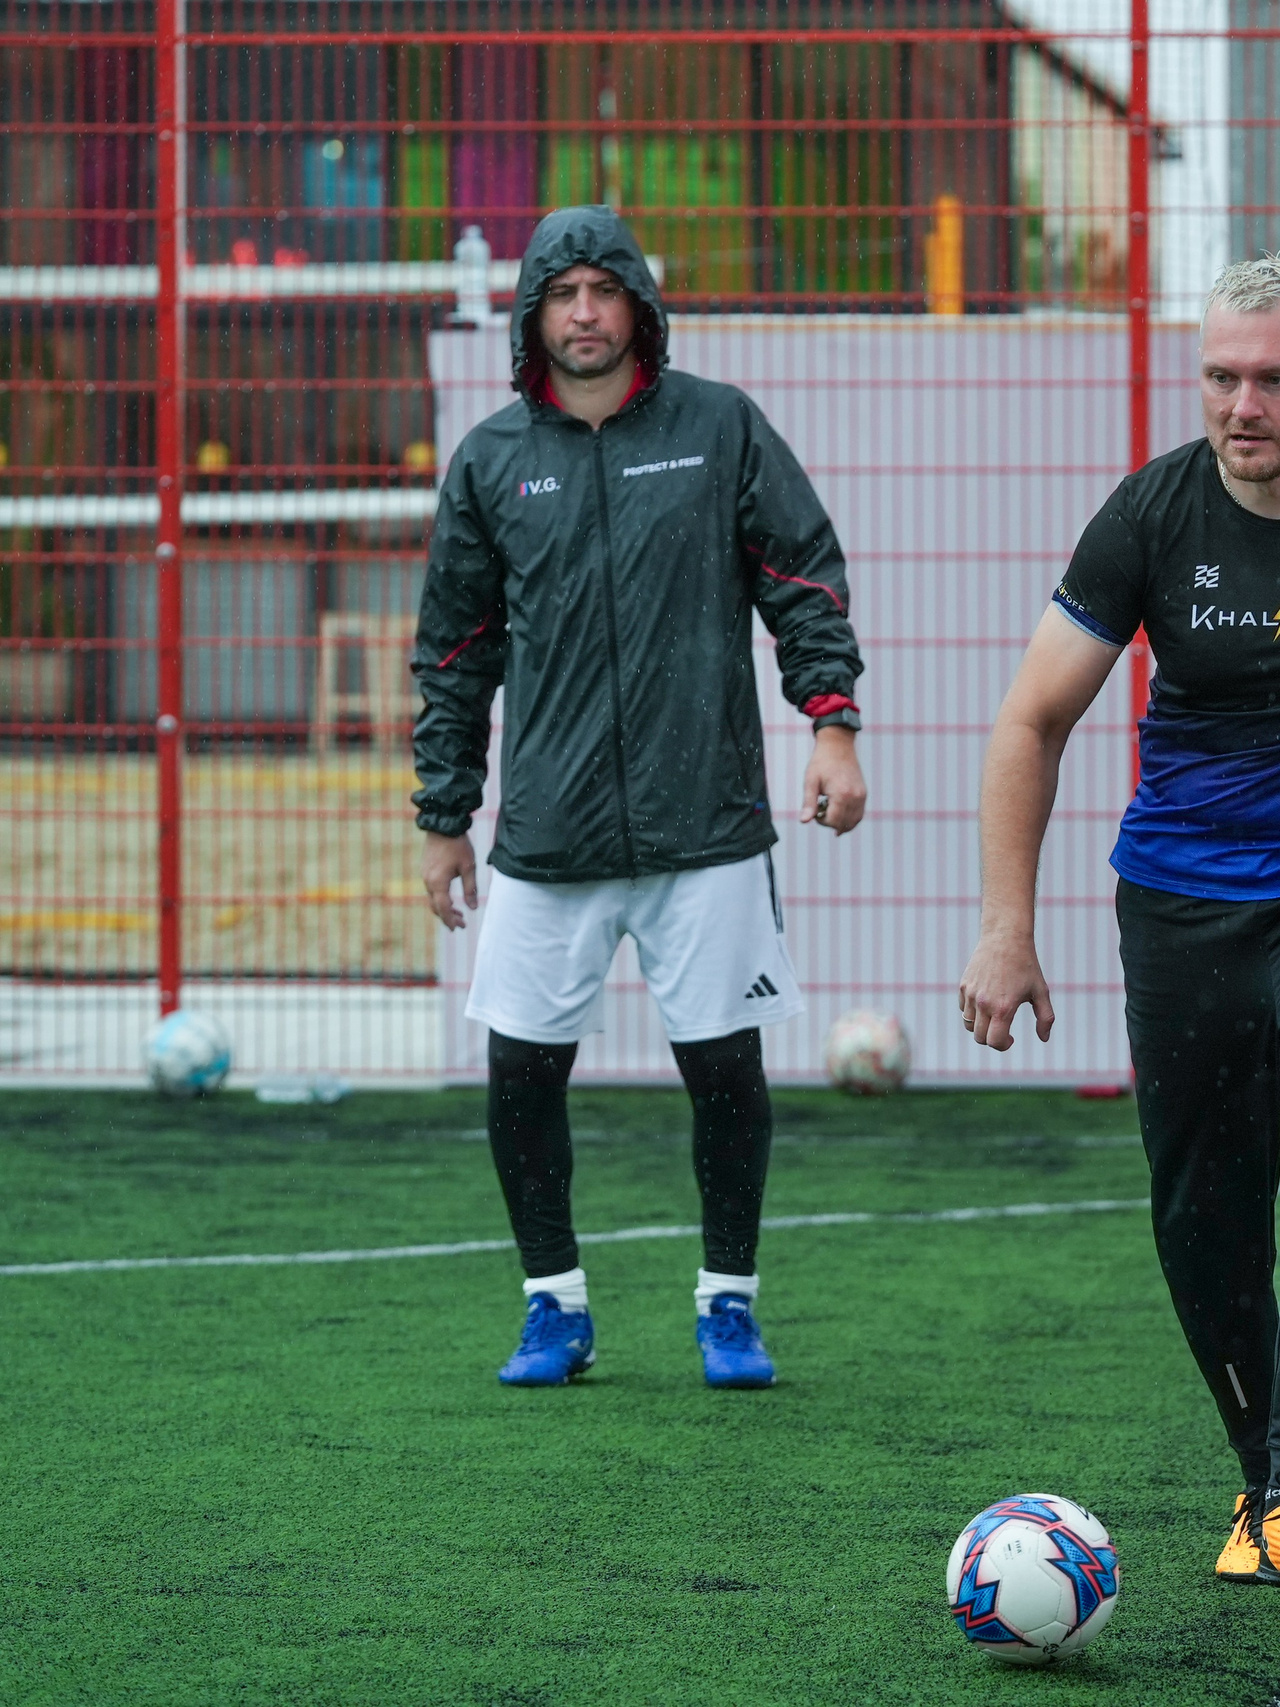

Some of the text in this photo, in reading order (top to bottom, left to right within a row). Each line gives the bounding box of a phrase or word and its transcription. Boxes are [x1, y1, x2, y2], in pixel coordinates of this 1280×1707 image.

[623, 456, 704, 477] PROTECT & FEED
